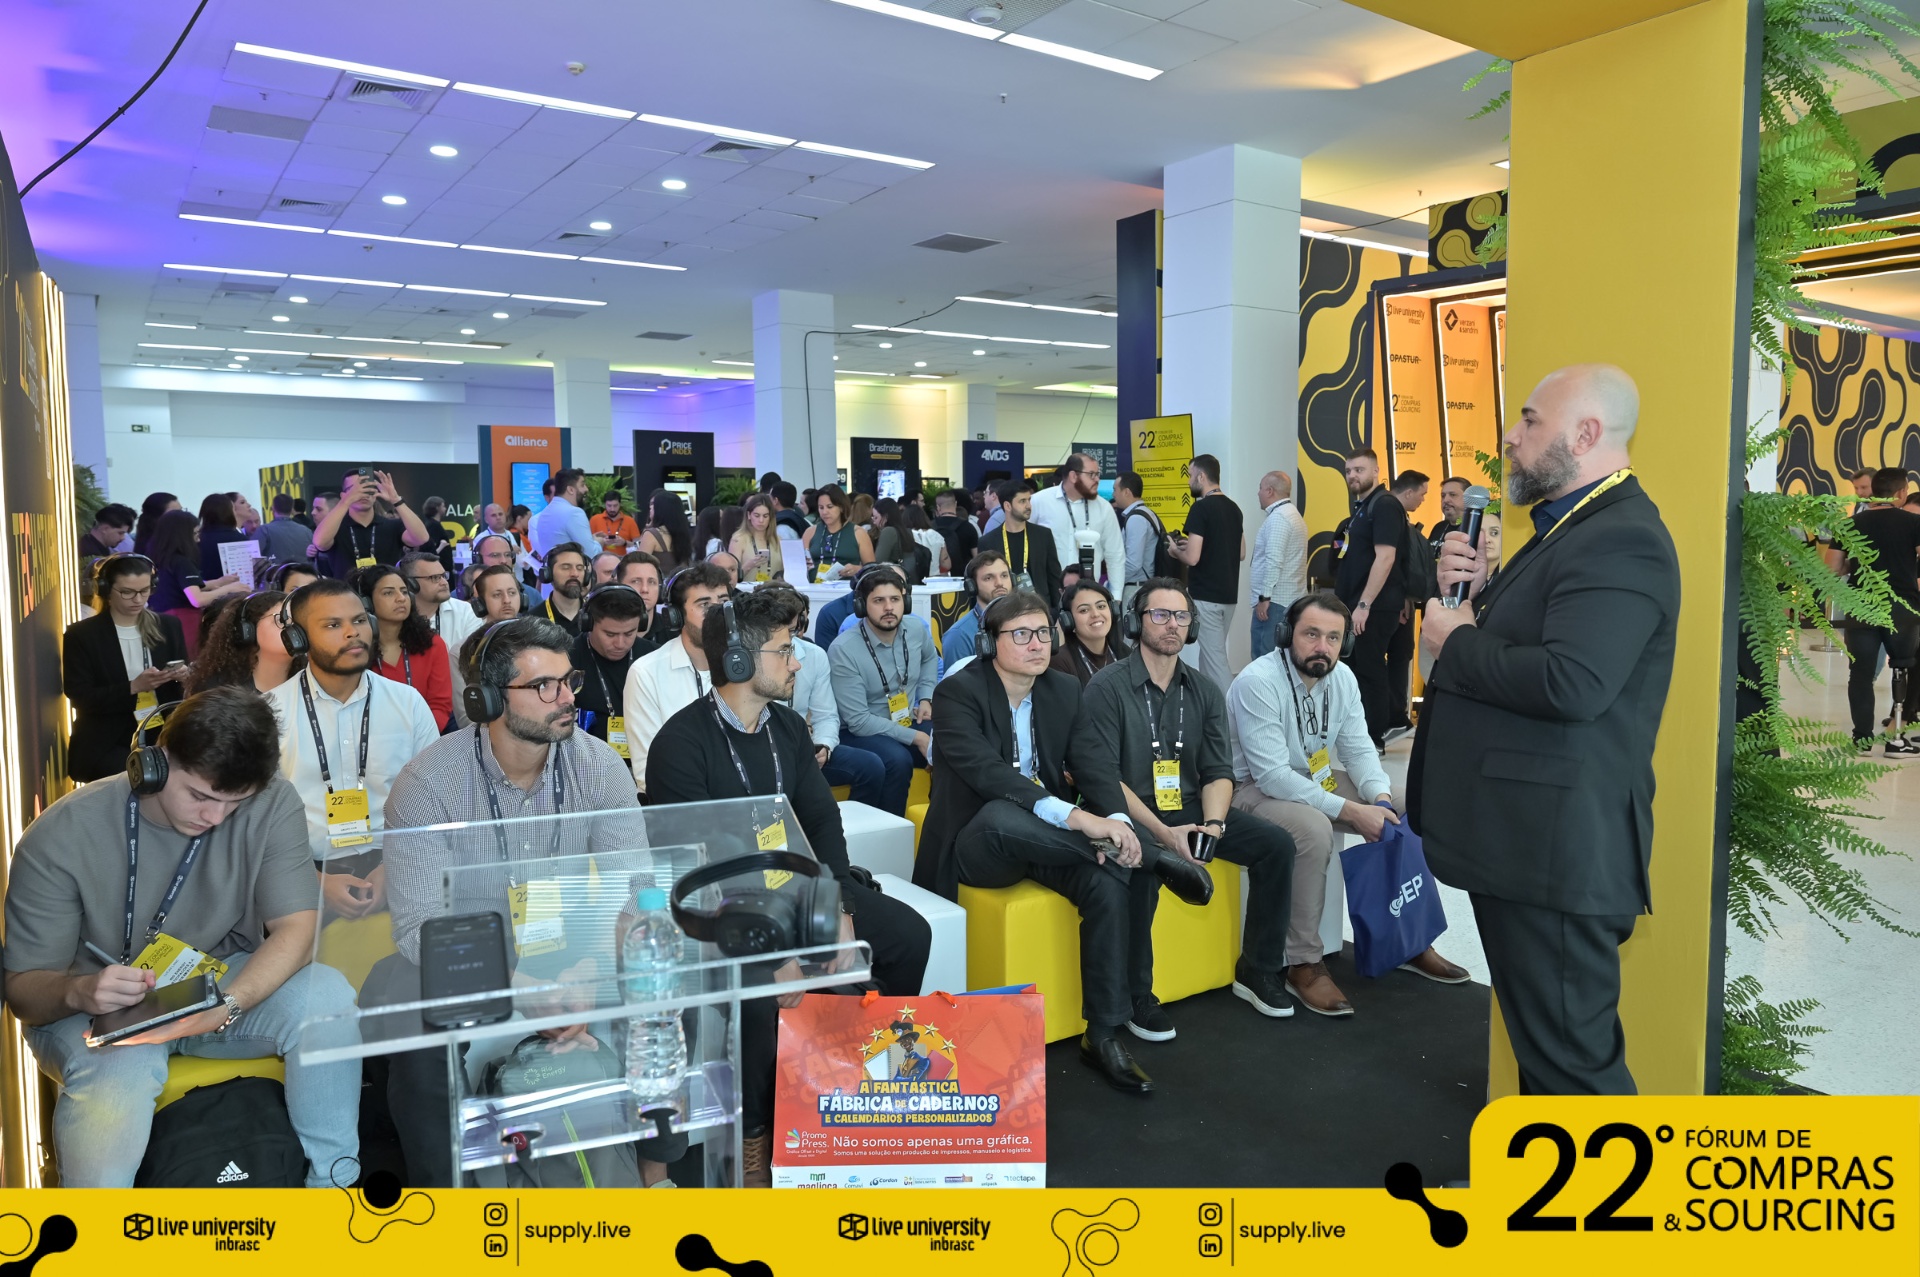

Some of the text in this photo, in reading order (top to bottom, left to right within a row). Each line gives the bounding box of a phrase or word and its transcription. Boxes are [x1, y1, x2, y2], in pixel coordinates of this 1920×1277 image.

[1158, 433, 1183, 441] COMPRAS
[672, 441, 692, 449] PRICE
[869, 443, 903, 453] Brasfrotas
[981, 449, 1010, 461] 4MDG
[542, 1066, 566, 1079] Energy
[860, 1076, 959, 1094] A FANTÁSTICA
[819, 1088, 999, 1112] FÁBRICA DE CADERNOS
[825, 1109, 993, 1124] E CALENDÁRIOS PERSONALIZADOS
[801, 1131, 828, 1139] Promo
[833, 1134, 1033, 1149] Não somos apenas uma gráfica.
[868, 1149, 892, 1157] solução
[902, 1149, 931, 1157] produção
[1006, 1146, 1033, 1155] logística.
[216, 1172, 249, 1184] adidas
